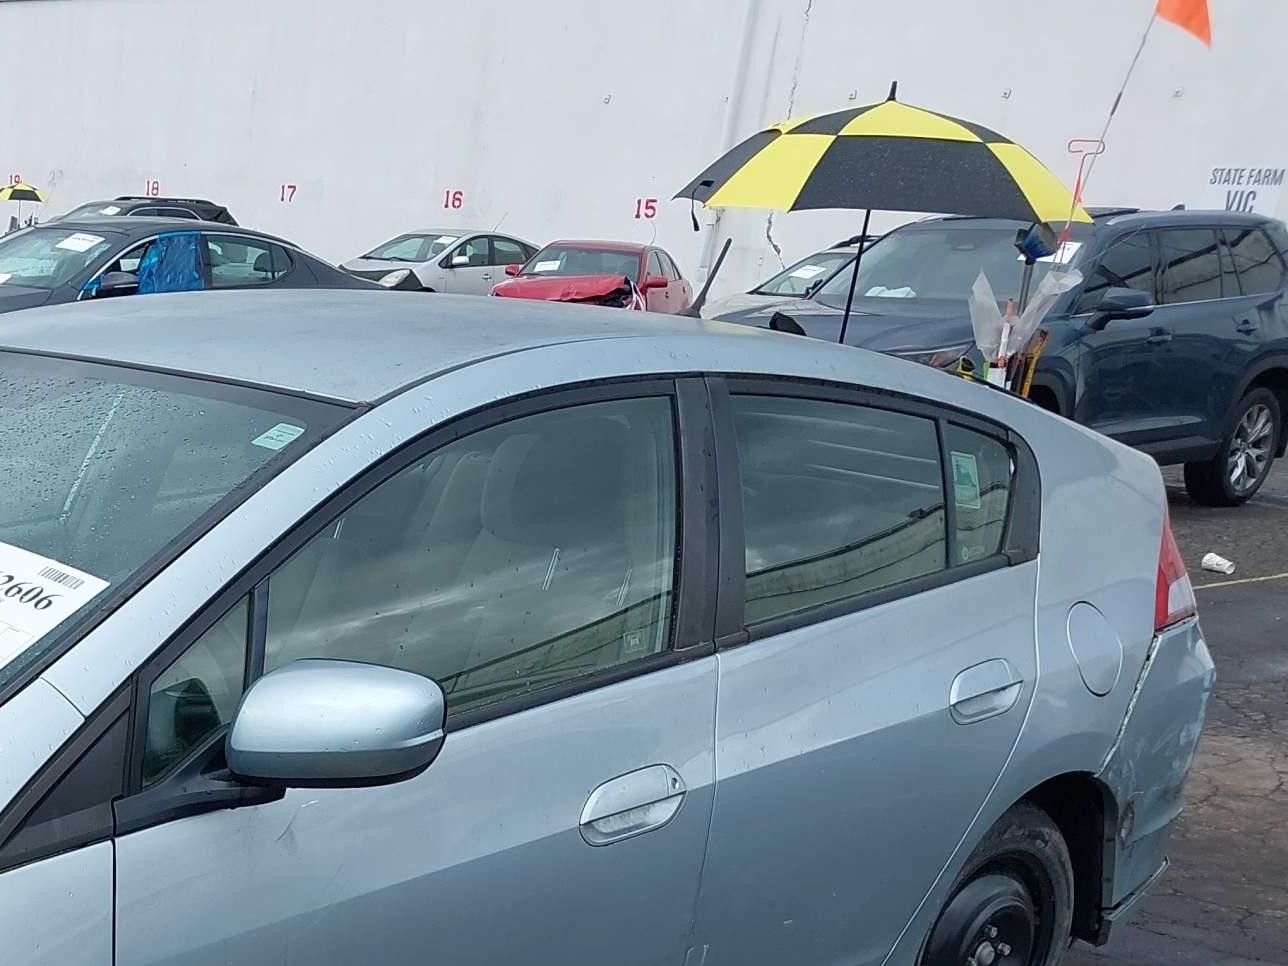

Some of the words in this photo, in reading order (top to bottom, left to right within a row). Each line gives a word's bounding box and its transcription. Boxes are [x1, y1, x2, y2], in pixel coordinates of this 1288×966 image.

[1209, 168, 1246, 185] STATE
[1247, 168, 1285, 186] FARM
[146, 180, 159, 196] 18
[280, 184, 297, 202] 17
[443, 190, 463, 209] 16
[1225, 190, 1257, 213] VIC
[634, 199, 658, 219] 15
